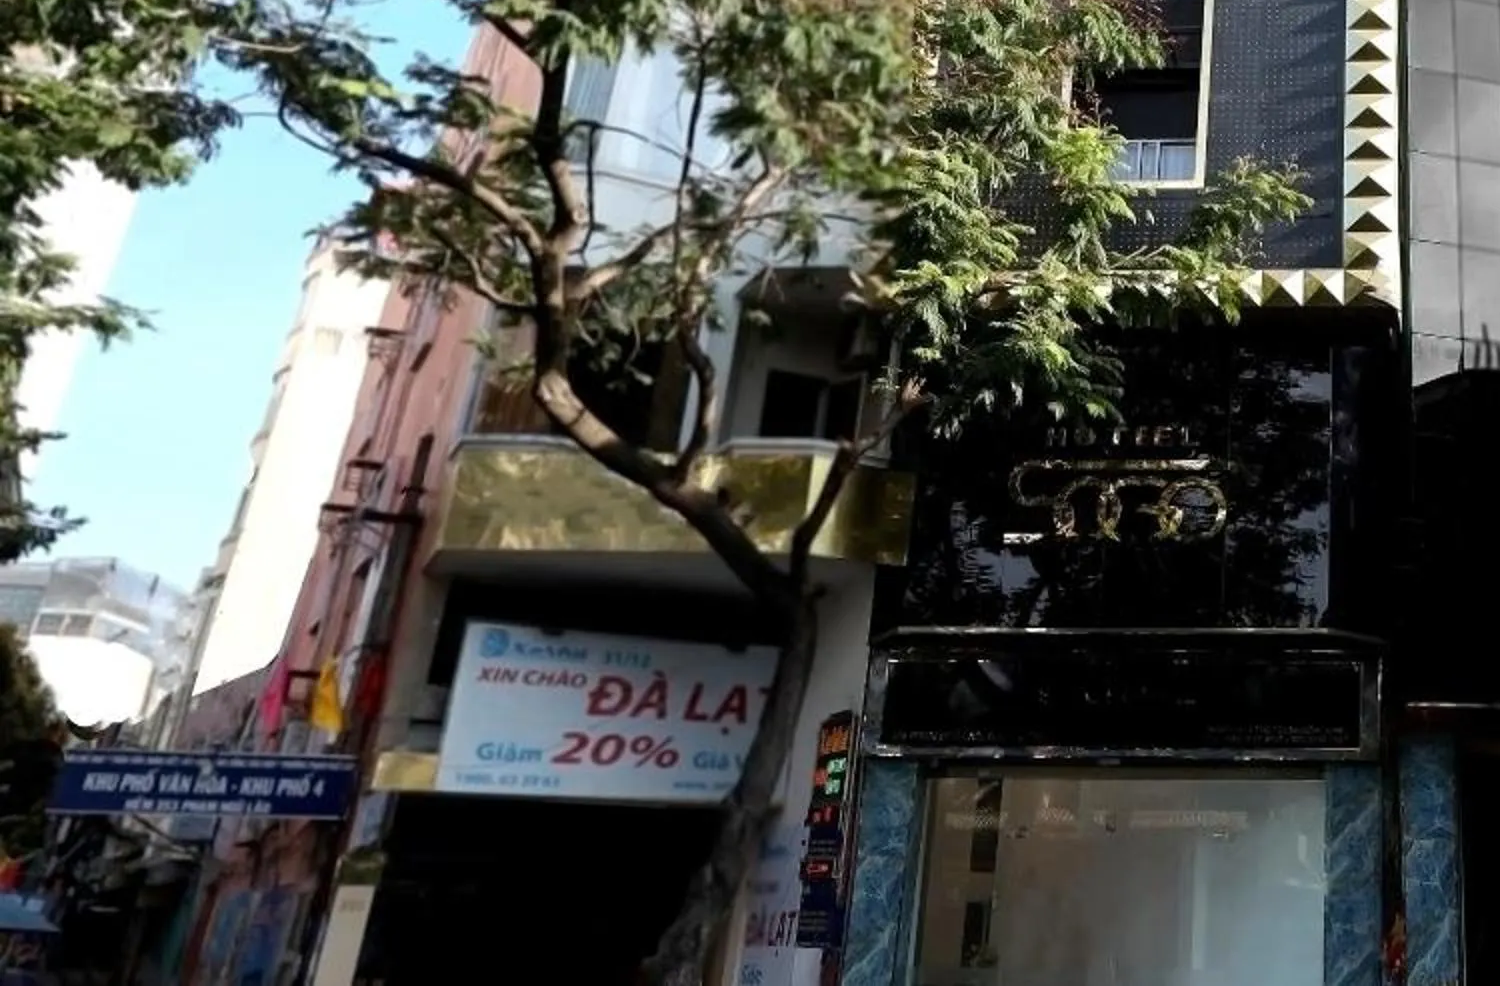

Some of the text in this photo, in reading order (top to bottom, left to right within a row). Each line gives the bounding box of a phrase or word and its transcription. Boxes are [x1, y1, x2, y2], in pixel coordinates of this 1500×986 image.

[476, 665, 519, 685] XIN
[521, 667, 589, 690] CHÀO
[586, 670, 668, 721] ĐÀ
[475, 741, 544, 766] Giảm
[551, 730, 680, 770] 20%
[82, 771, 120, 792] KHU
[119, 767, 160, 793] PHỐ
[240, 776, 275, 797] KHU
[276, 772, 314, 798] PHỐ
[313, 778, 325, 798] 4
